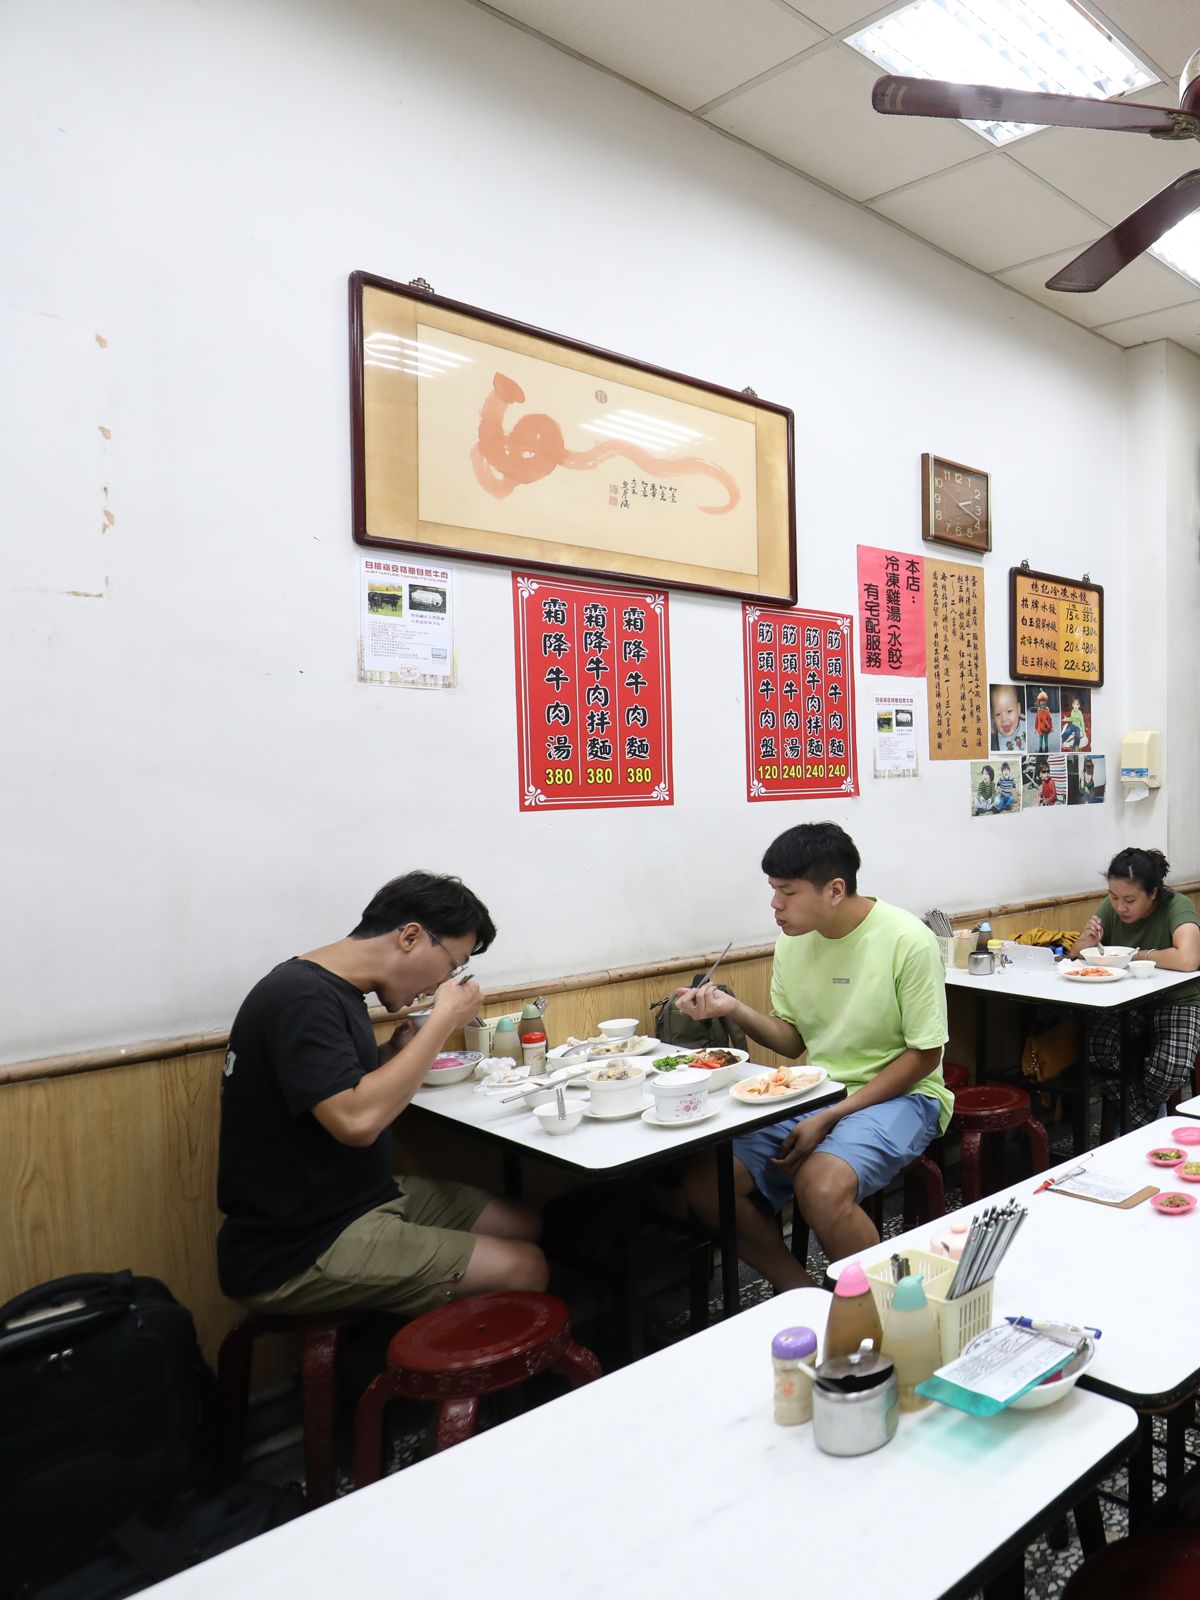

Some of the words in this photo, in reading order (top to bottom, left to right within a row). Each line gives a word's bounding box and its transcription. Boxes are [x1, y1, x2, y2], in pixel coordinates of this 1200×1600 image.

[935, 477, 943, 488] 10
[944, 470, 951, 481] 11
[955, 473, 963, 484] 12
[967, 478, 971, 488] 1
[934, 493, 941, 503] 9
[974, 489, 981, 499] 2
[935, 511, 942, 520] 8
[975, 505, 982, 516] 3
[945, 522, 951, 532] 7
[955, 527, 962, 536] 6
[974, 520, 980, 530] 4
[966, 528, 973, 538] 5
[1021, 596, 1057, 615] 招牌水餃
[864, 583, 881, 668] 有宅配服務
[542, 597, 573, 762] 霜降牛肉湯
[583, 603, 613, 762] 霜降牛肉拌麵
[622, 607, 650, 760] 霜降牛肉麵
[757, 622, 777, 759] 筋頭牛肉盤
[781, 624, 801, 759] 筋頭牛肉湯
[804, 626, 824, 758] 筋頭牛肉拌麵
[827, 629, 845, 758] 筋頭牛肉麵
[545, 768, 573, 785] 380
[586, 767, 613, 784] 380
[627, 766, 652, 784] 380
[758, 765, 778, 779] 120
[782, 765, 802, 779] 240
[805, 764, 825, 778] 240
[828, 764, 846, 778] 240
